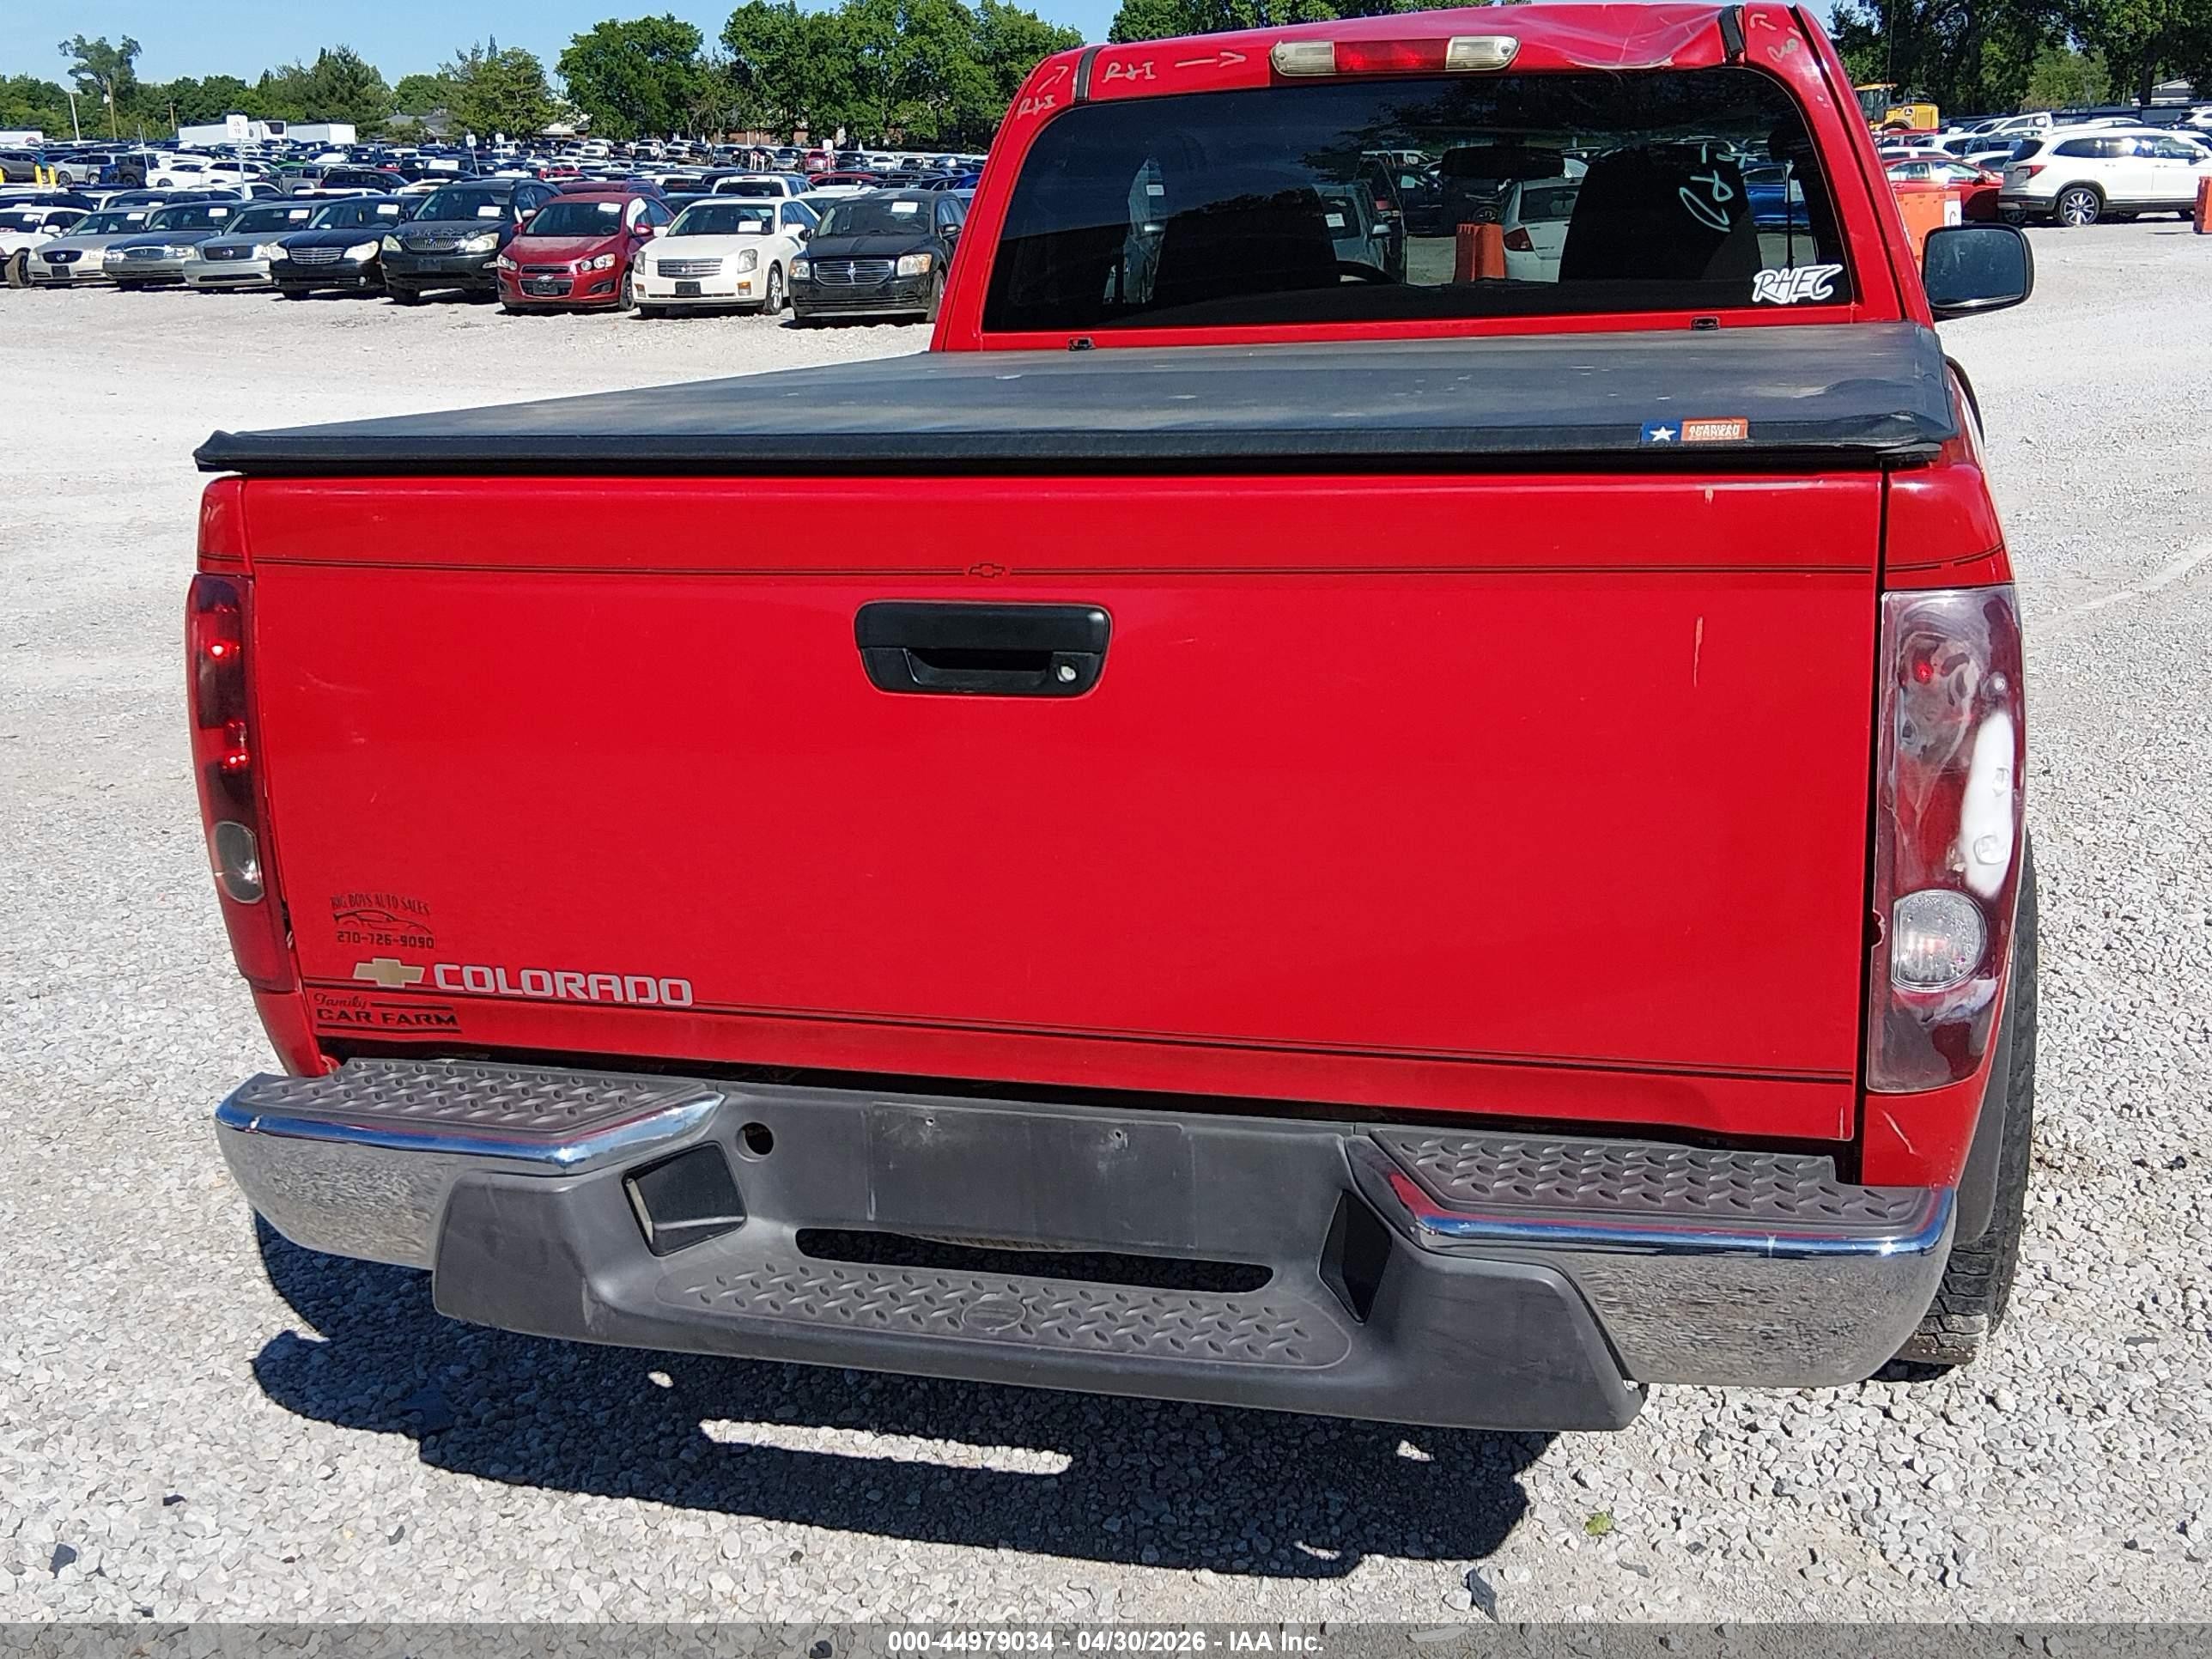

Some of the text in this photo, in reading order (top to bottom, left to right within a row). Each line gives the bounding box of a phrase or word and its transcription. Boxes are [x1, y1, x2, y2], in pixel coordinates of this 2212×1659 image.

[375, 894, 398, 908] AUTO
[401, 897, 430, 916] SALES
[337, 931, 434, 949] 270-726-9090
[434, 963, 693, 1006] COLORADO
[317, 1008, 459, 1025] CAR FARM
